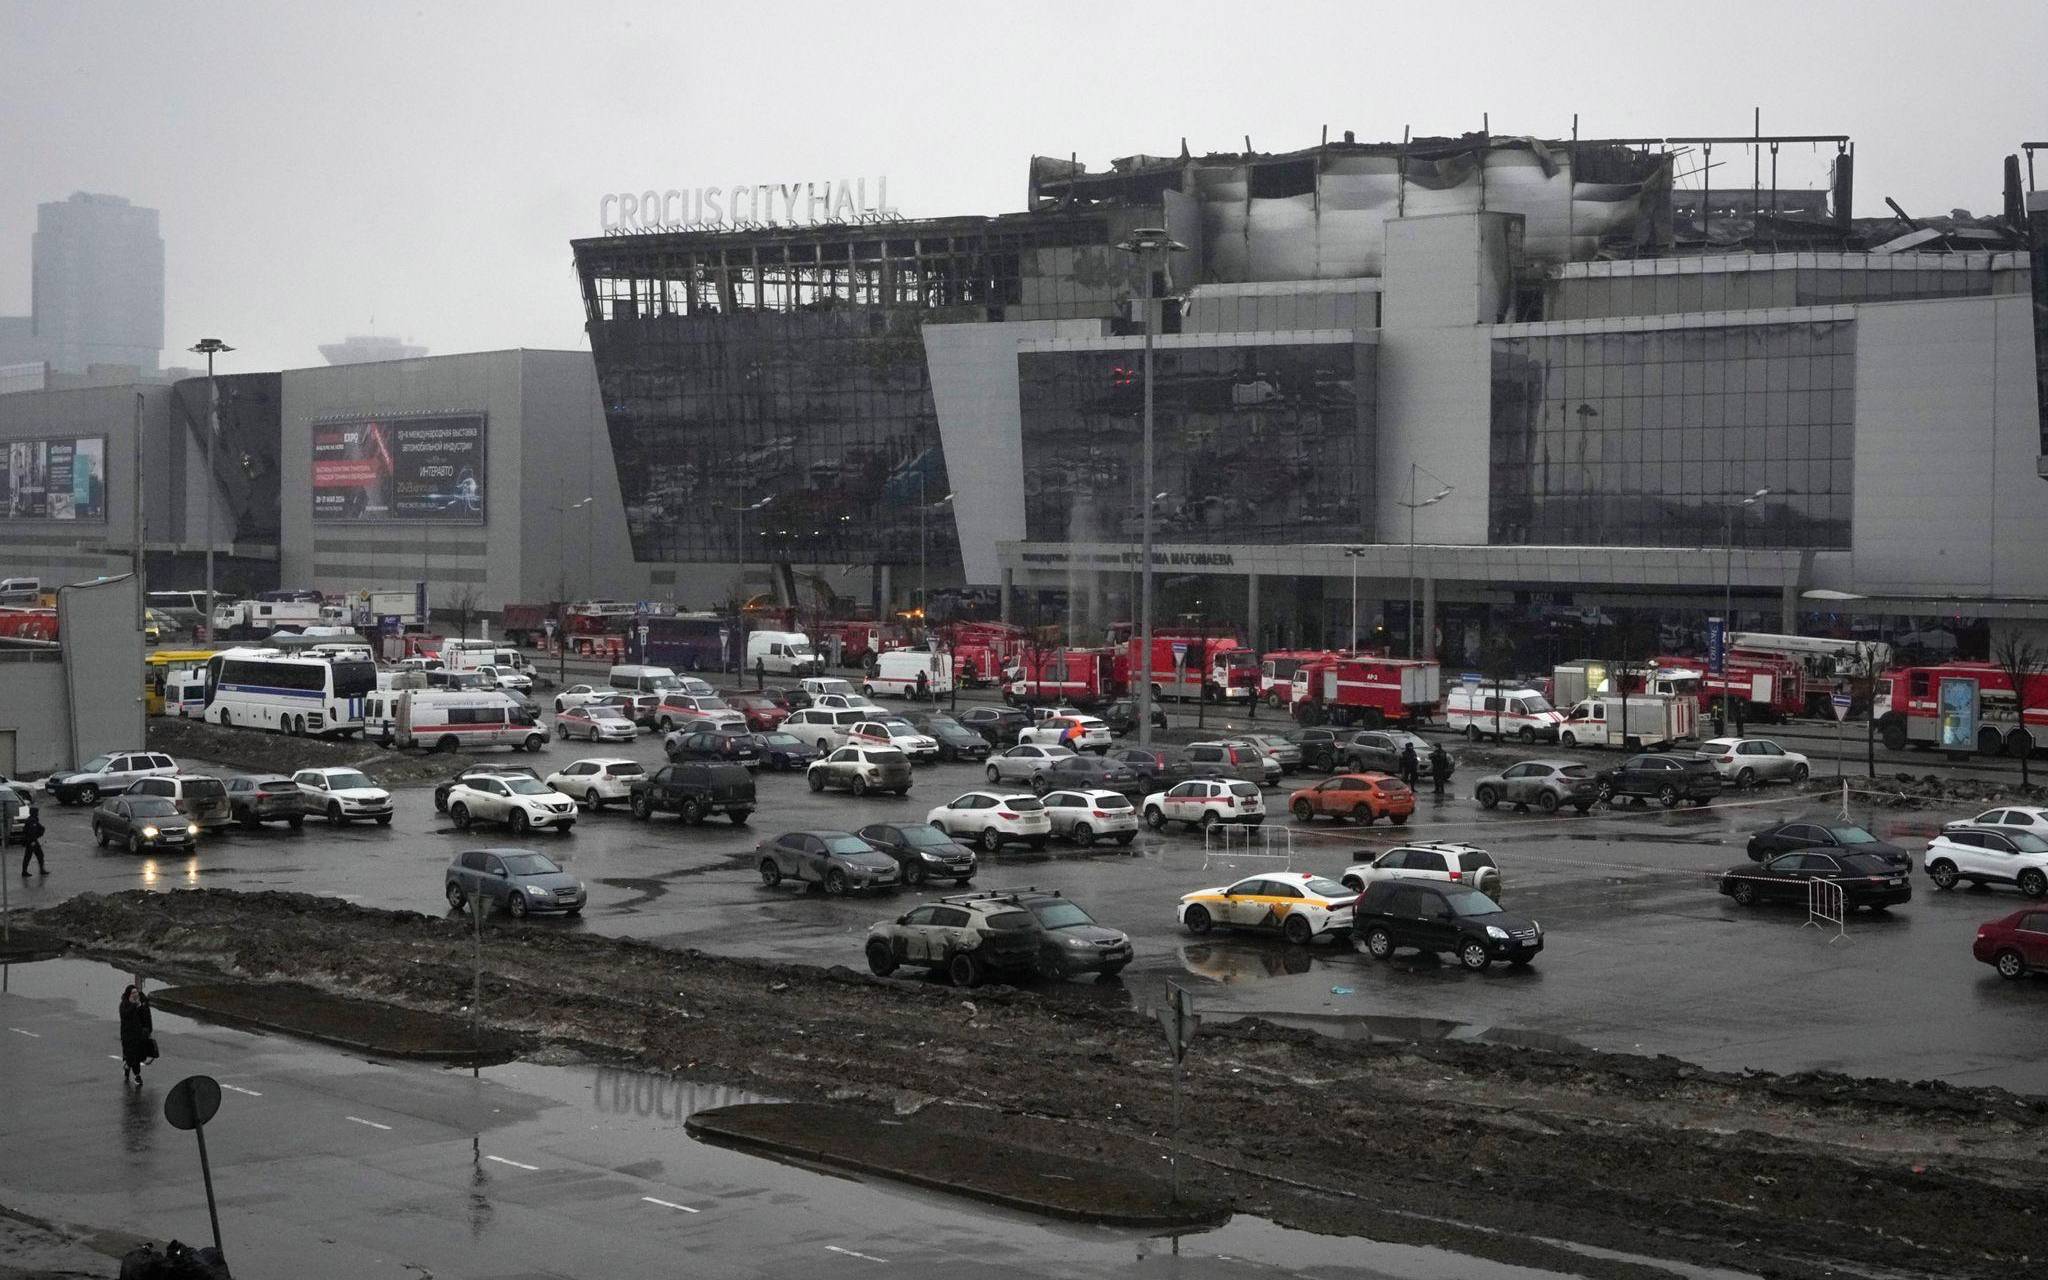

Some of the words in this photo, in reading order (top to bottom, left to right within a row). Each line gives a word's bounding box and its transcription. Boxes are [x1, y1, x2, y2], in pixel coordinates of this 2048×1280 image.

[600, 187, 723, 230] CROCUS
[730, 182, 801, 225] CITY
[807, 176, 897, 220] HALL
[419, 465, 454, 477] ИНТЕРАВТО
[1170, 552, 1234, 566] МАГОМАЕВА
